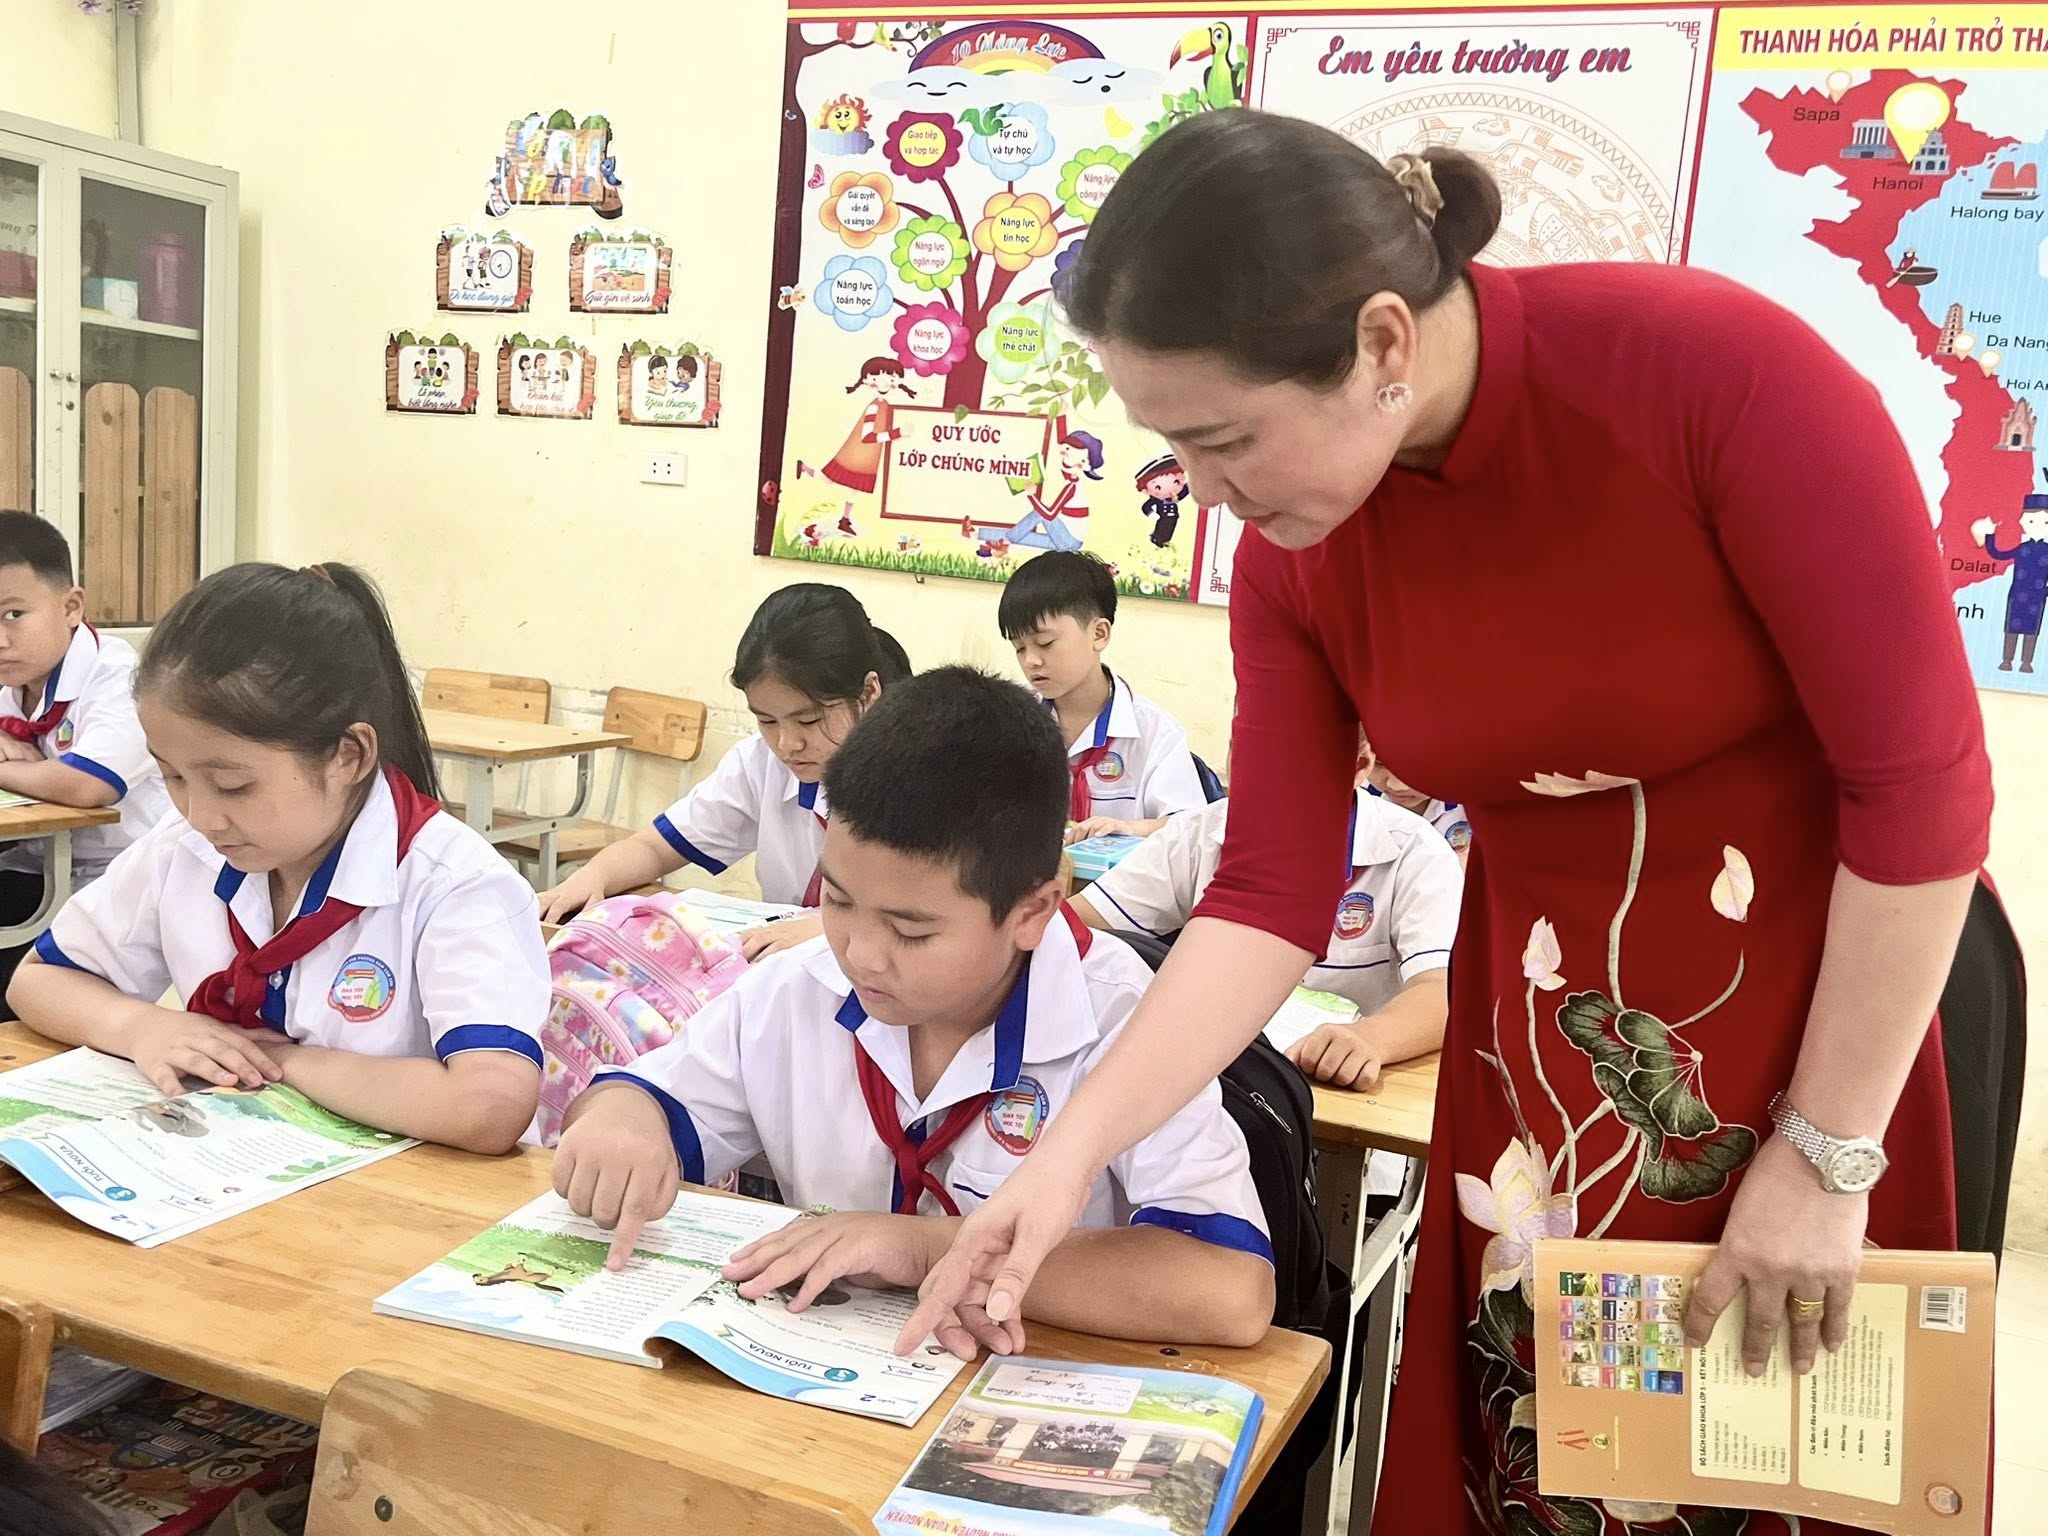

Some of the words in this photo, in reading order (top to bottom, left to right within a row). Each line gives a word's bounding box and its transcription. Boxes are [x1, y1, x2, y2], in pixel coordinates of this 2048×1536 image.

[1739, 28, 1821, 54] THANH
[1828, 22, 1880, 53] HÓA
[1888, 17, 1947, 52] PHẢI
[1955, 17, 2005, 52] TRỞ
[952, 40, 972, 63] 10
[1318, 35, 1374, 75] Em
[1383, 41, 1443, 82] yêu
[1452, 39, 1569, 82] trường
[1579, 45, 1632, 73] em
[1793, 107, 1841, 123] Sapa
[992, 146, 1002, 155] và
[1004, 146, 1015, 156] tự
[1016, 146, 1032, 157] học
[1872, 176, 1925, 191] Hanoi
[1950, 205, 2009, 222] Halong
[2014, 206, 2044, 222] bay
[1000, 217, 1021, 228] Năng
[1022, 217, 1035, 228] lực
[1004, 234, 1015, 243] tin
[1016, 234, 1030, 244] học
[837, 281, 858, 292] Năng
[860, 281, 873, 291] lực
[837, 295, 855, 305] toán
[856, 296, 872, 307] học
[1969, 310, 2002, 324] Hue
[1002, 326, 1023, 337] Năng
[1025, 327, 1039, 337] lực
[1986, 334, 2008, 348] Da
[2013, 336, 2048, 352] Nan
[2006, 378, 2031, 390] Hoi
[931, 424, 965, 442] QUY
[969, 424, 1001, 444] ƯỚC
[898, 448, 927, 468] LỚP
[931, 452, 985, 473] CHÚNG
[989, 454, 1030, 477] MÌNH
[1950, 558, 1997, 574] Dalat
[859, 1394, 877, 1402] 2
[1699, 1405, 1707, 1422] KHOA
[1699, 1439, 1707, 1457] SÁCH
